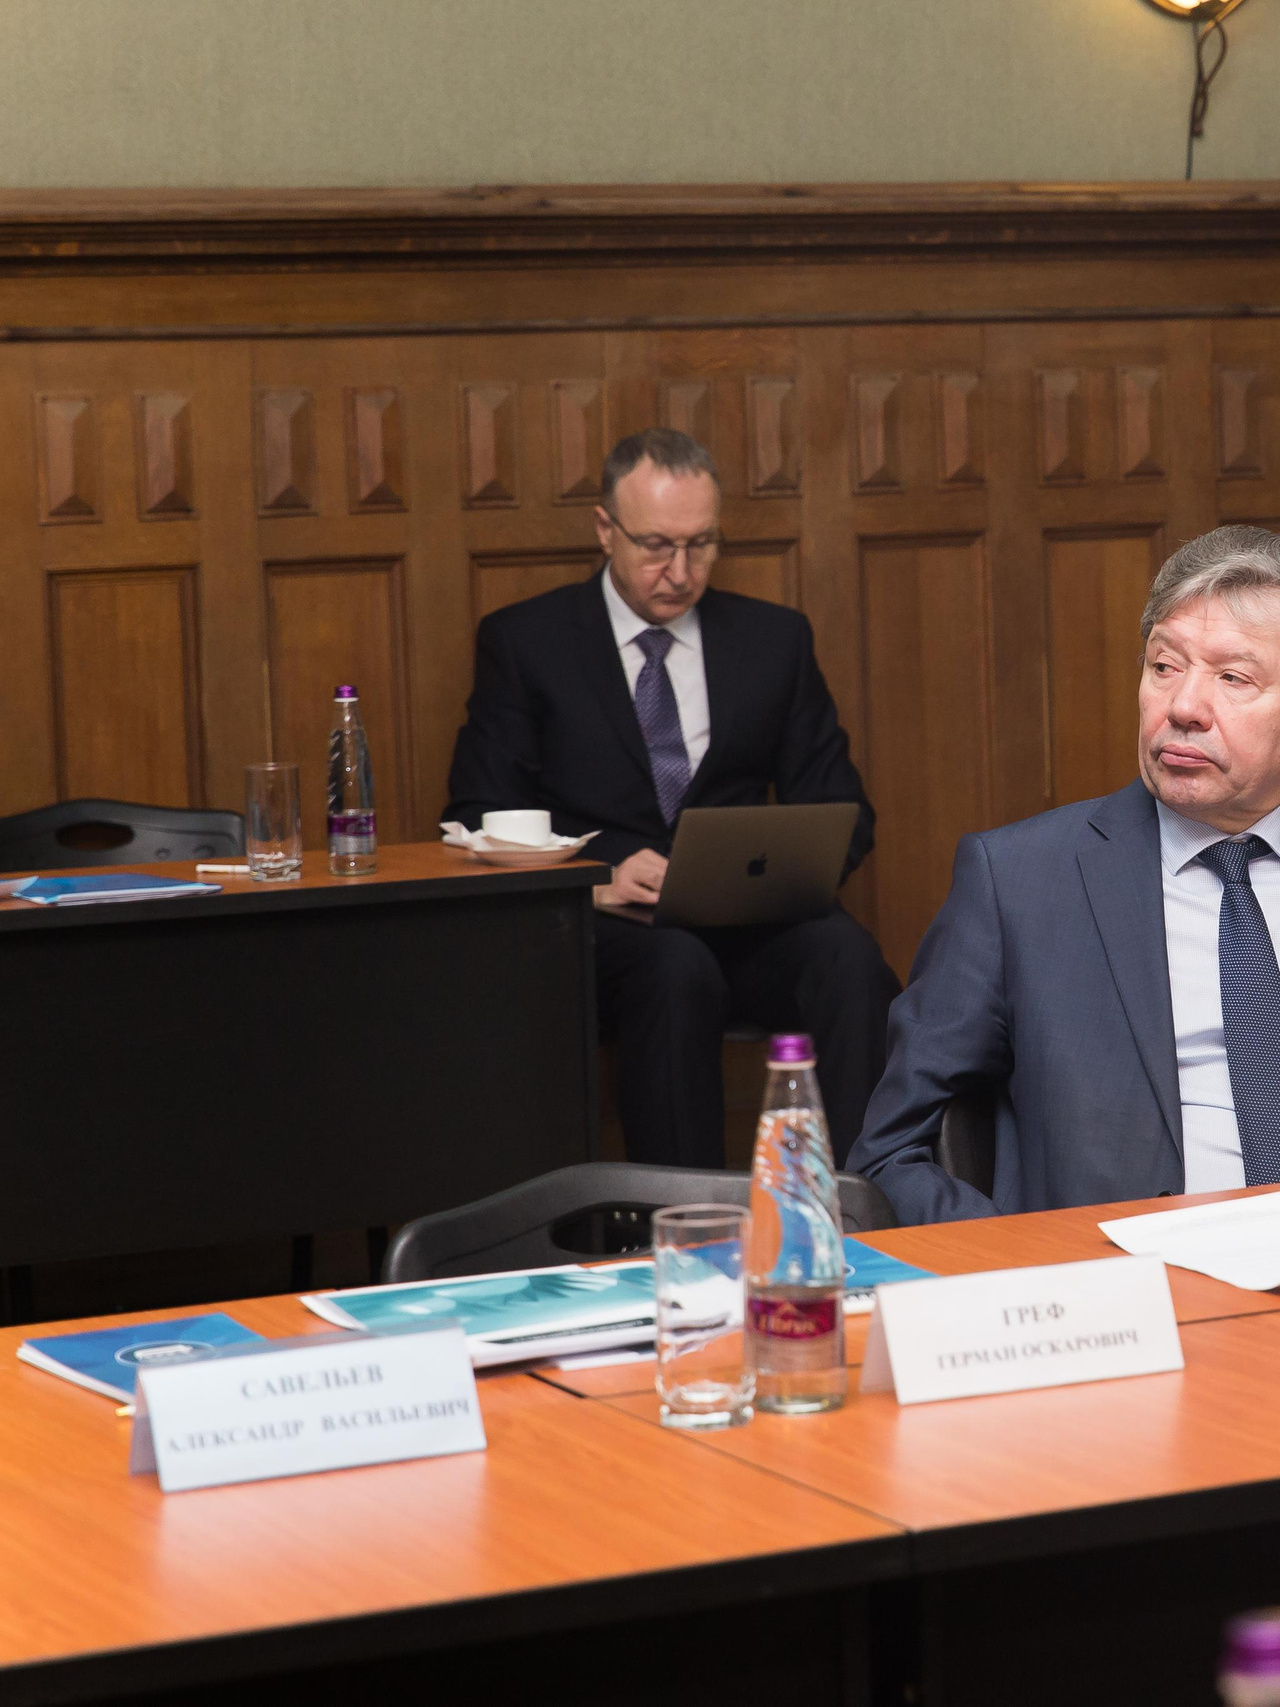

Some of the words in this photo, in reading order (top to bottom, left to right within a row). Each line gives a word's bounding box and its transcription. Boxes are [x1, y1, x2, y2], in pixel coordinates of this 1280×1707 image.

[1002, 1302, 1065, 1327] ГРЕФ
[937, 1346, 1017, 1370] ГЕРМАН
[1022, 1330, 1139, 1358] ОСКАРОВИЧ
[240, 1364, 384, 1400] САВЕЛЬЕВ
[167, 1420, 304, 1455] АЛЕКСАНДР
[321, 1398, 471, 1433] ВАСИЛЬЕВИЧ
